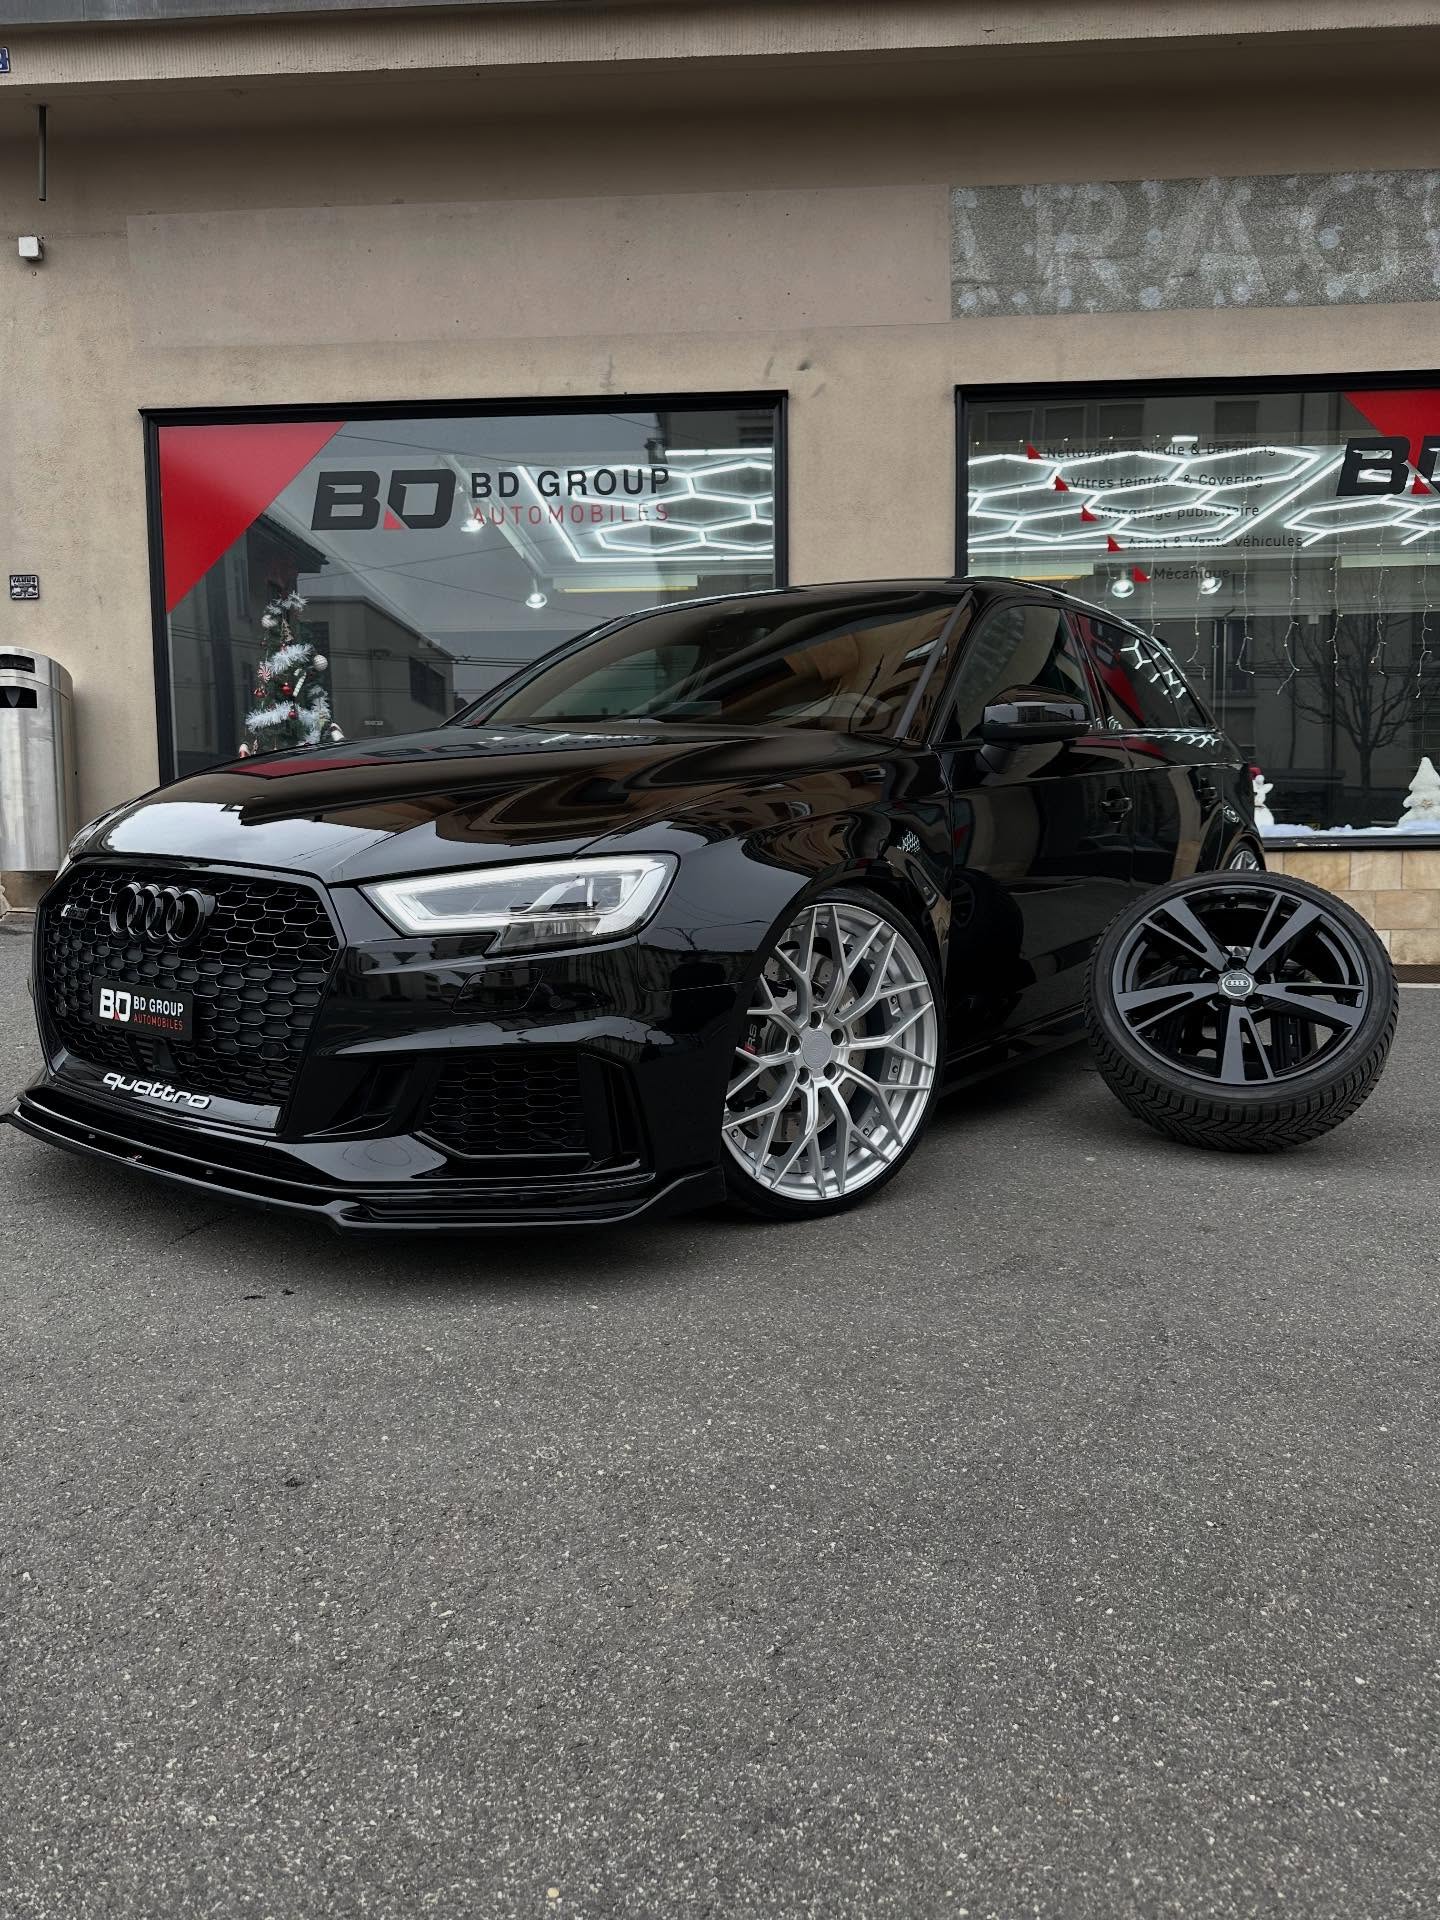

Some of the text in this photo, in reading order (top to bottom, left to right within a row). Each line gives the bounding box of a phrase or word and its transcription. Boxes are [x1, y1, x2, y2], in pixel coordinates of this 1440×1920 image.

[1124, 443, 1185, 456] hicule
[1191, 443, 1200, 455] &
[471, 468, 670, 499] BD GROUP
[1071, 476, 1114, 489] Vitres
[1183, 474, 1193, 485] &
[1199, 473, 1263, 489] Covering
[311, 469, 457, 531] BD
[471, 502, 670, 525] AUTOMOBILES
[1177, 504, 1259, 520] publicire
[1235, 532, 1303, 549] véhicules
[1154, 567, 1230, 580] Mécanique
[99, 987, 132, 1022] BD
[133, 995, 184, 1017] BD GROUP
[133, 1012, 184, 1031] AUTOMOBILES
[103, 1071, 211, 1110] quattro
